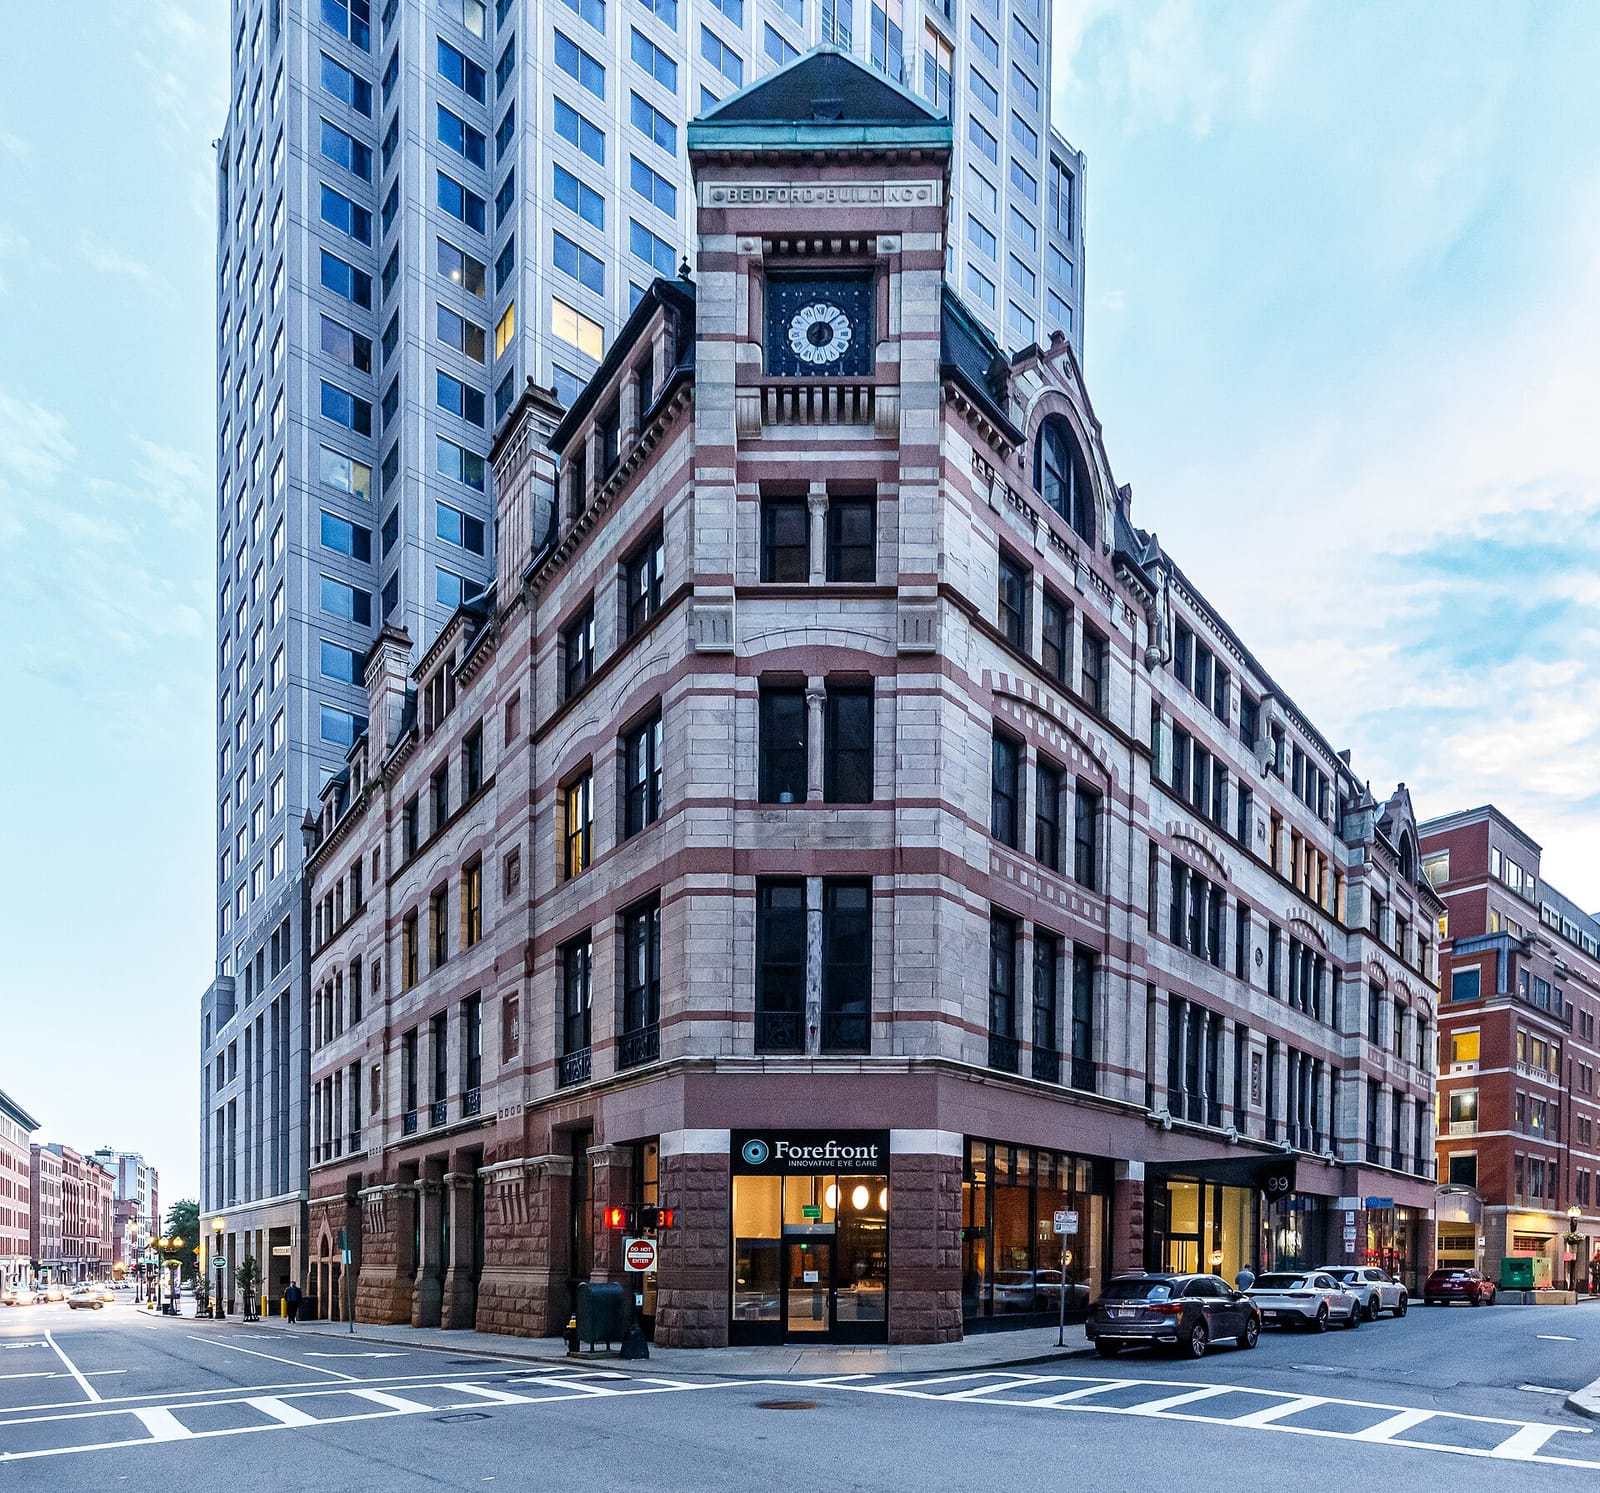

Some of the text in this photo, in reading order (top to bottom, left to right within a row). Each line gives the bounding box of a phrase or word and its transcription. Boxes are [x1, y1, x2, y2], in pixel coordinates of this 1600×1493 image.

[727, 188, 914, 203] BEDFORD BUILDING
[775, 1141, 878, 1159] Forefront
[1269, 1177, 1288, 1191] 99
